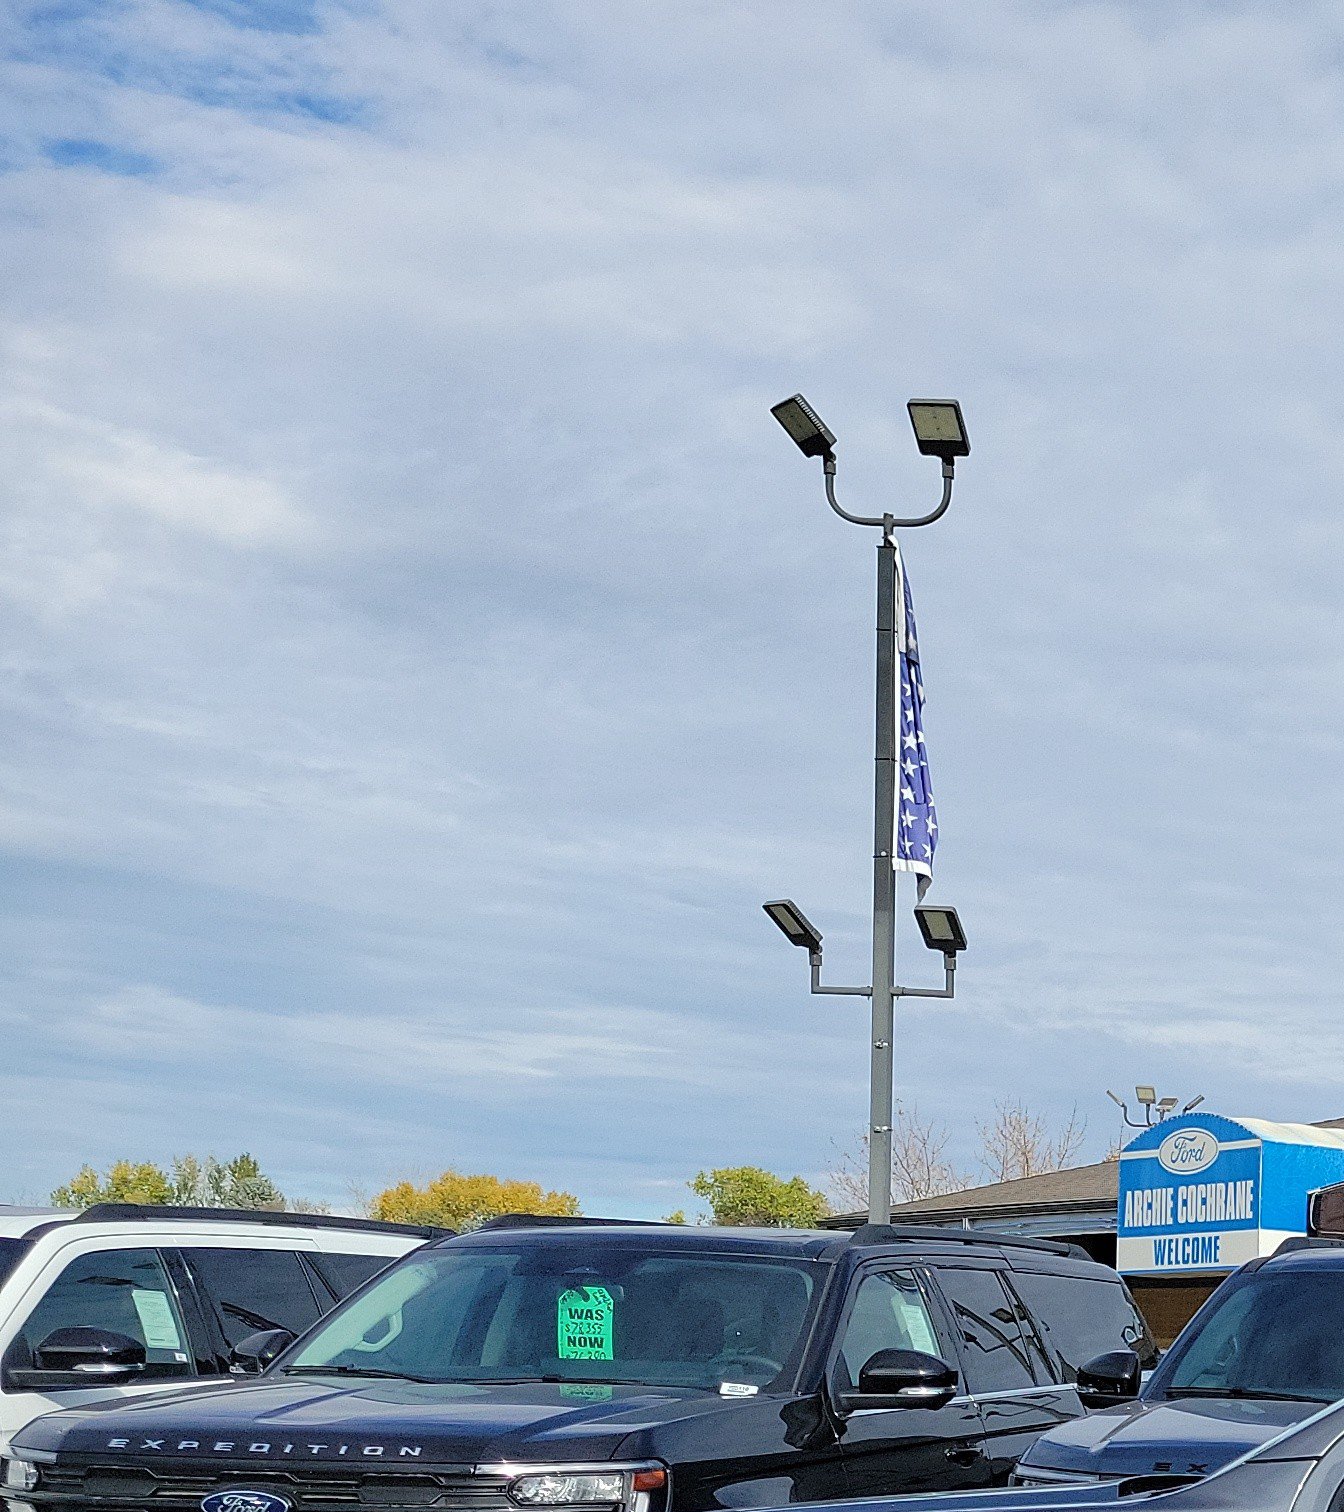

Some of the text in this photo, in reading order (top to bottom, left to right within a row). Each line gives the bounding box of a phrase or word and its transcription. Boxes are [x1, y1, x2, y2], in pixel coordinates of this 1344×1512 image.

[1170, 1136, 1206, 1164] Ford
[1124, 1180, 1254, 1228] ARCHIE COCHRANE
[1153, 1235, 1220, 1266] WELCOME
[568, 1307, 605, 1321] WAS
[567, 1336, 605, 1349] NOW
[107, 1438, 423, 1457] EXPEDITION
